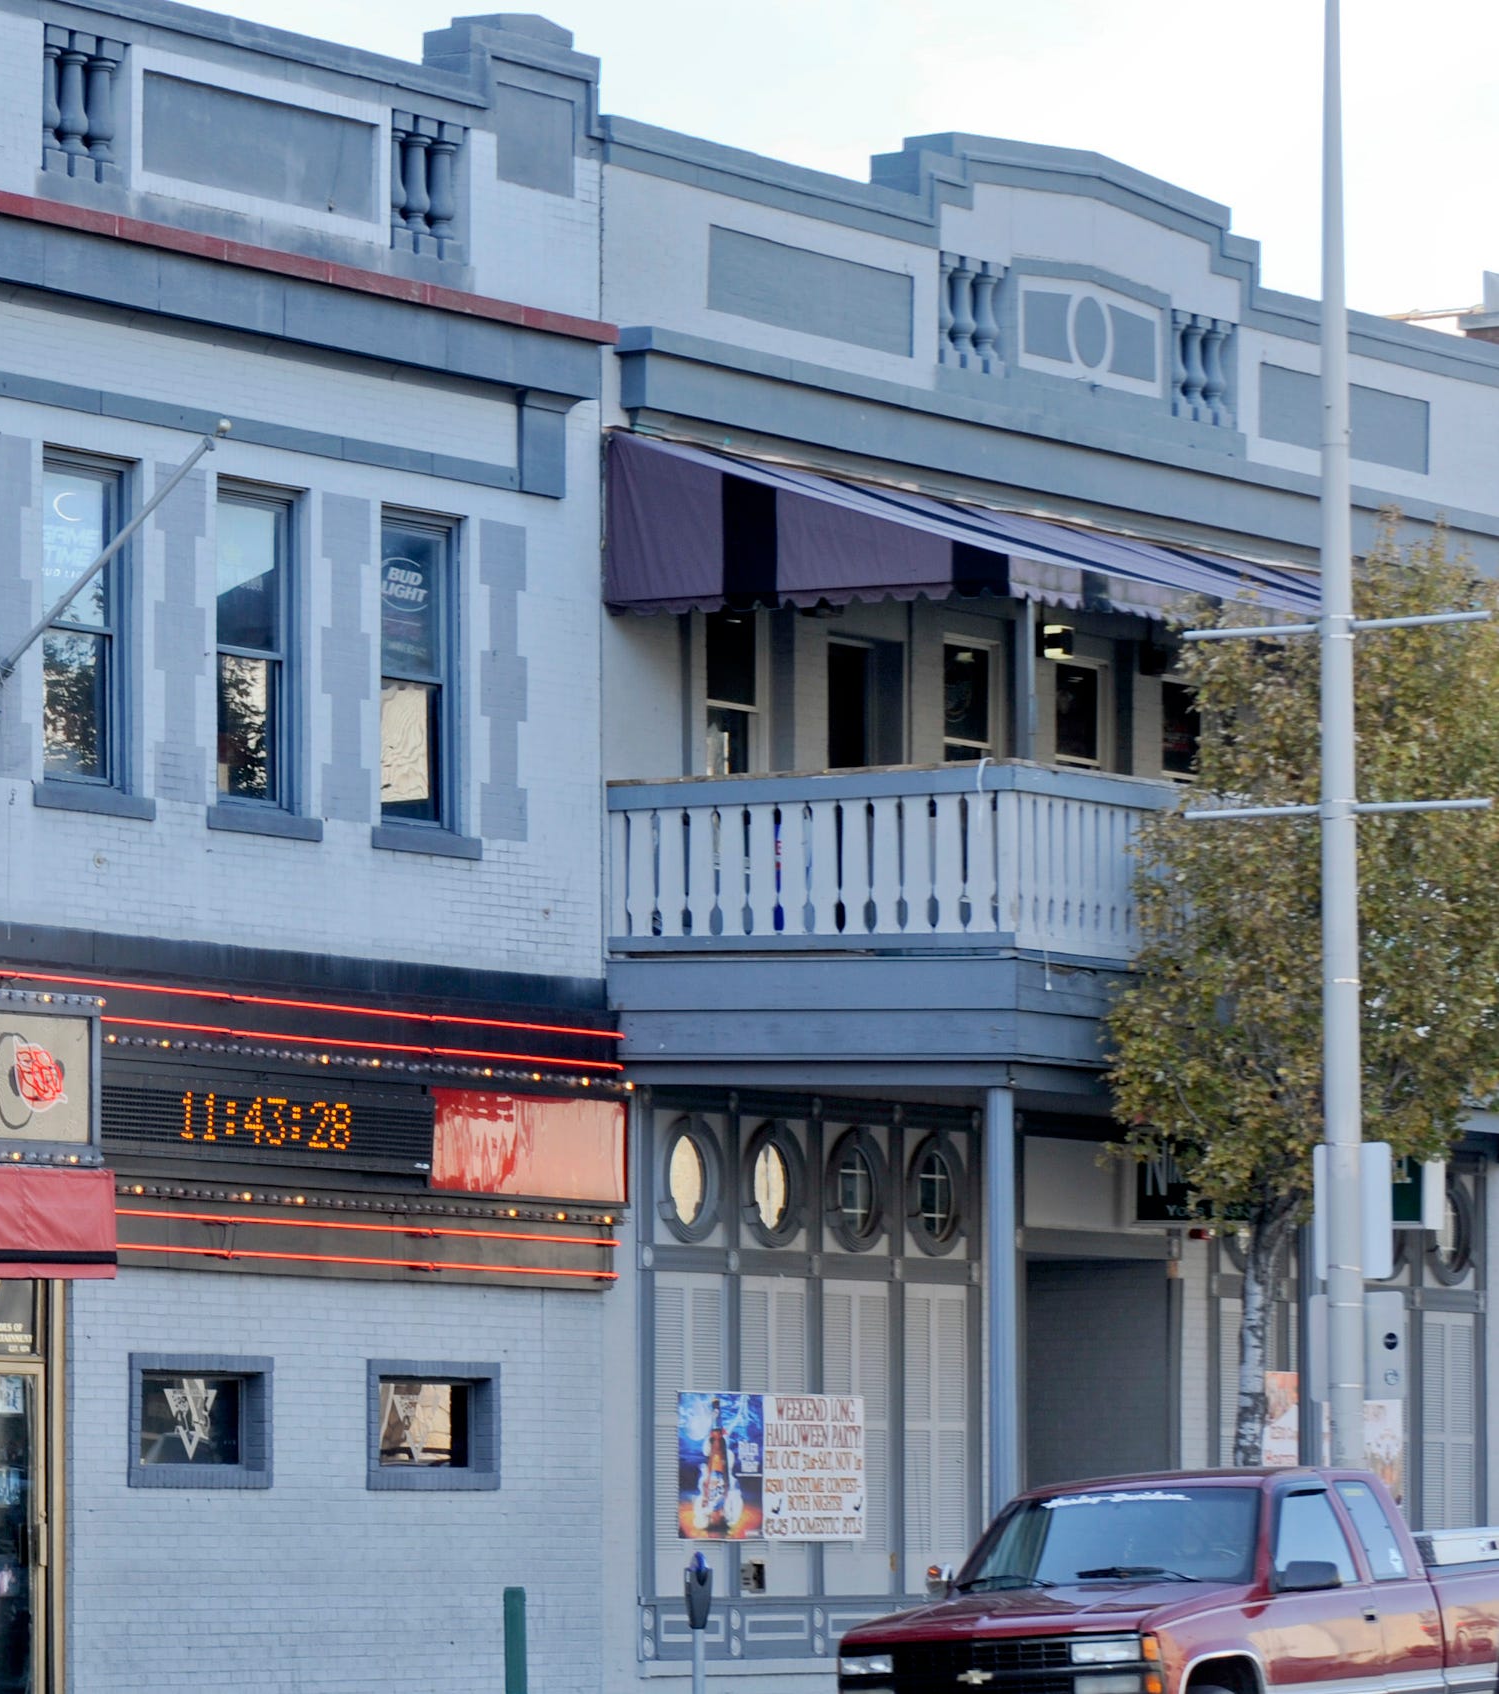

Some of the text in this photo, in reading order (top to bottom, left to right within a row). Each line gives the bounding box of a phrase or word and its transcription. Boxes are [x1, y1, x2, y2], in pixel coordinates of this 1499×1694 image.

[387, 566, 423, 586] BUD
[381, 581, 429, 603] LIGHT
[180, 1090, 352, 1150] 11:43:28
[775, 1398, 855, 1422] WEEKEND LONG
[765, 1423, 829, 1448] HALLOWEEN
[781, 1450, 800, 1469] OCT
[786, 1477, 825, 1493] COSTUME
[788, 1495, 811, 1511] BOTH
[791, 1517, 840, 1534] DOMESTIC
